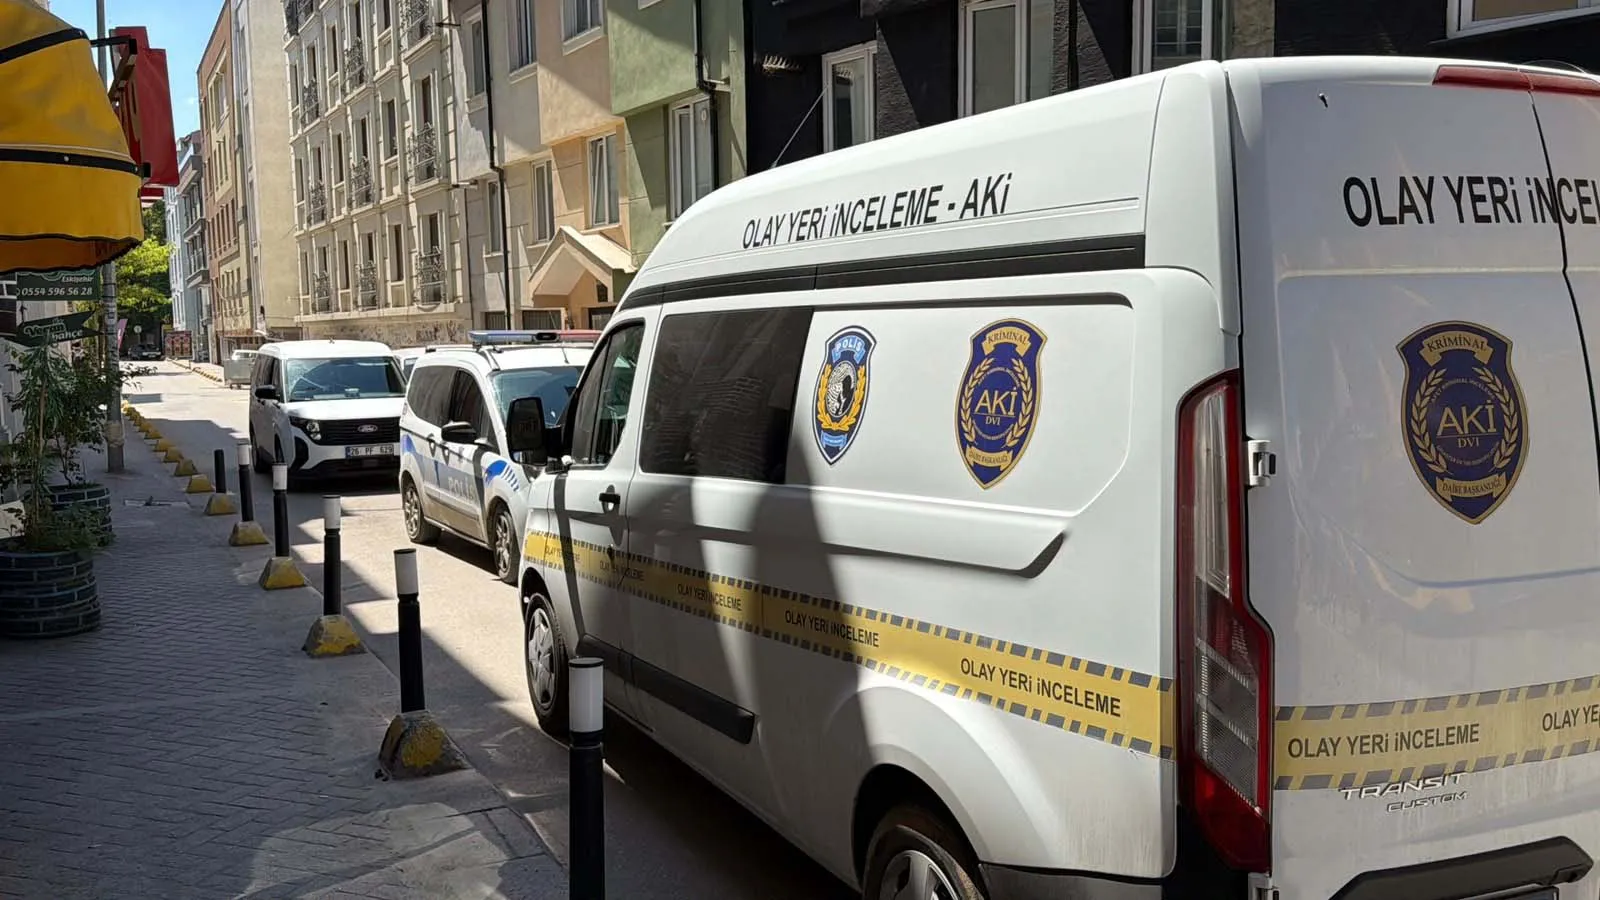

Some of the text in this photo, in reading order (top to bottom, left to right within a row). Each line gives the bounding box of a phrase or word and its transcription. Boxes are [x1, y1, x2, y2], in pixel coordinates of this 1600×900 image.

[1343, 175, 1434, 227] OLAY
[743, 212, 785, 249] OLAY
[21, 287, 93, 296] 0554 596 56 28
[1427, 334, 1487, 352] KRİMİNAL
[974, 387, 1018, 416] AKİ
[985, 416, 1001, 426] DVI
[1436, 399, 1497, 436] AKİ
[1458, 437, 1480, 448] DVI
[677, 584, 692, 597] OLAY
[785, 609, 807, 628] OLAY
[960, 657, 995, 682] OLAY
[1542, 703, 1600, 732] OLAY YE
[1288, 736, 1341, 759] OLAY
[1340, 771, 1467, 801] TRANSIT
[1386, 791, 1467, 812] CUSTOM
